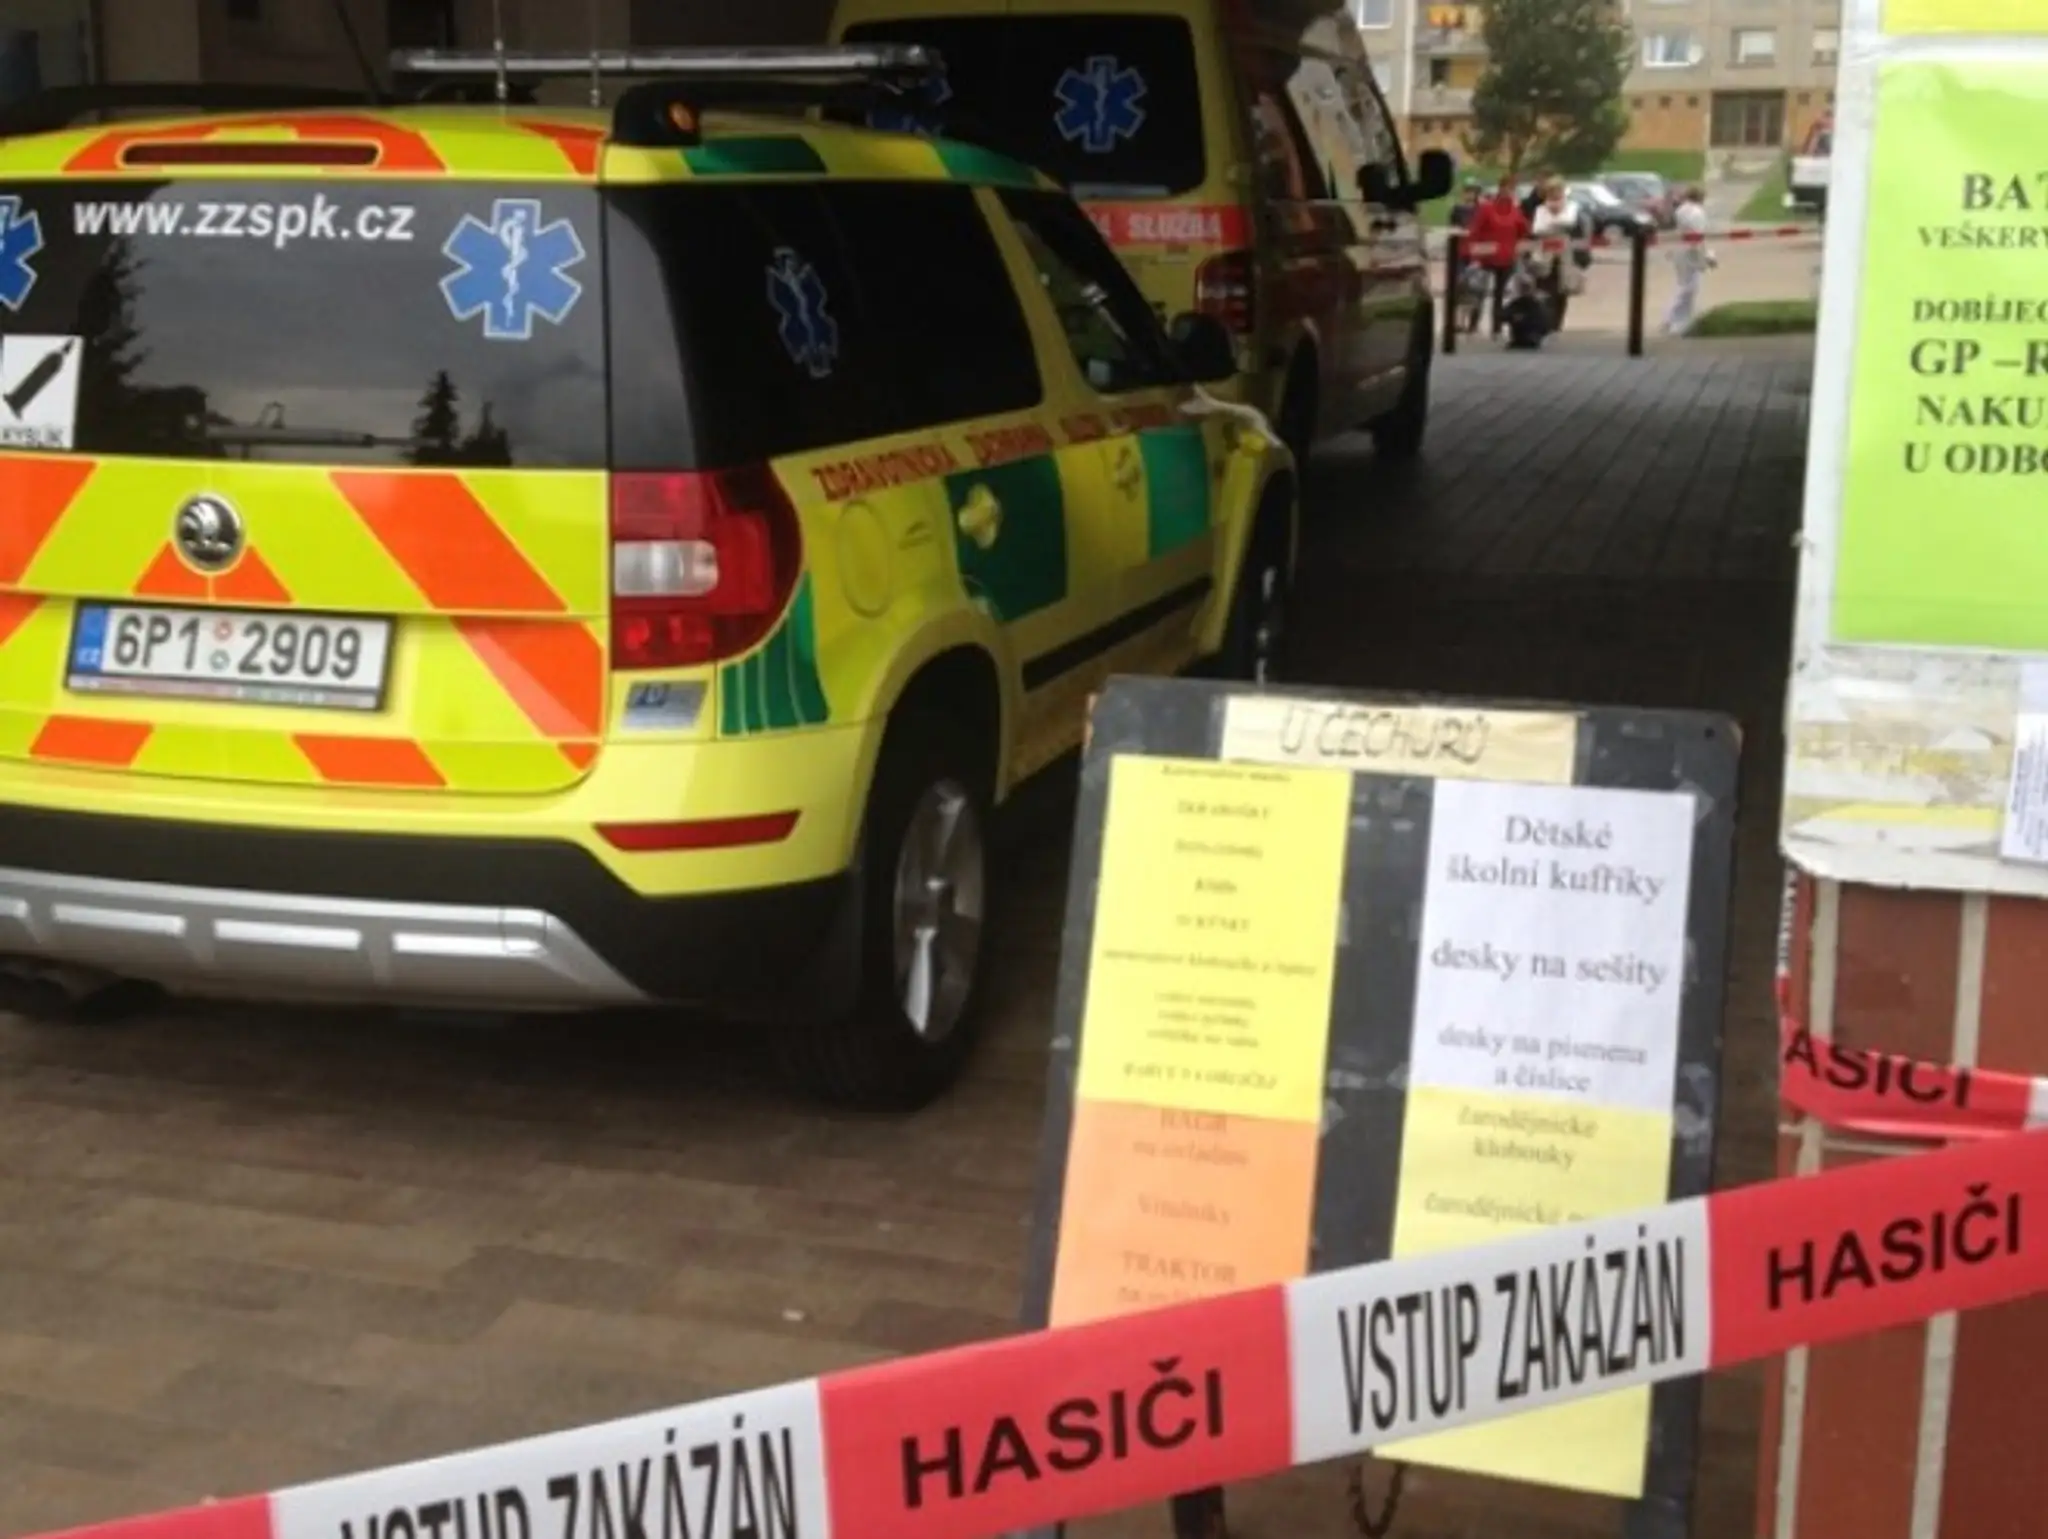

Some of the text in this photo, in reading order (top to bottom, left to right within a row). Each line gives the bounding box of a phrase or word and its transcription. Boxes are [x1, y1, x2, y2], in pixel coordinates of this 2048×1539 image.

[73, 192, 415, 249] www.zzspk.cz
[1909, 338, 1981, 376] GP
[1916, 396, 2044, 428] NAKU
[1904, 442, 1930, 474] U
[113, 613, 361, 679] 6P1 2909
[1505, 815, 1613, 850] Dětské
[1446, 853, 1665, 905] školní kufříky
[1431, 939, 1668, 994] desky na sešity
[1437, 1024, 1506, 1057] desky
[1512, 1035, 1541, 1054] na
[1766, 1183, 2021, 1310] HASIČI
[1338, 1225, 1687, 1436] VSTUP ZAKÁZÁN
[901, 1356, 1225, 1509] HASIČI
